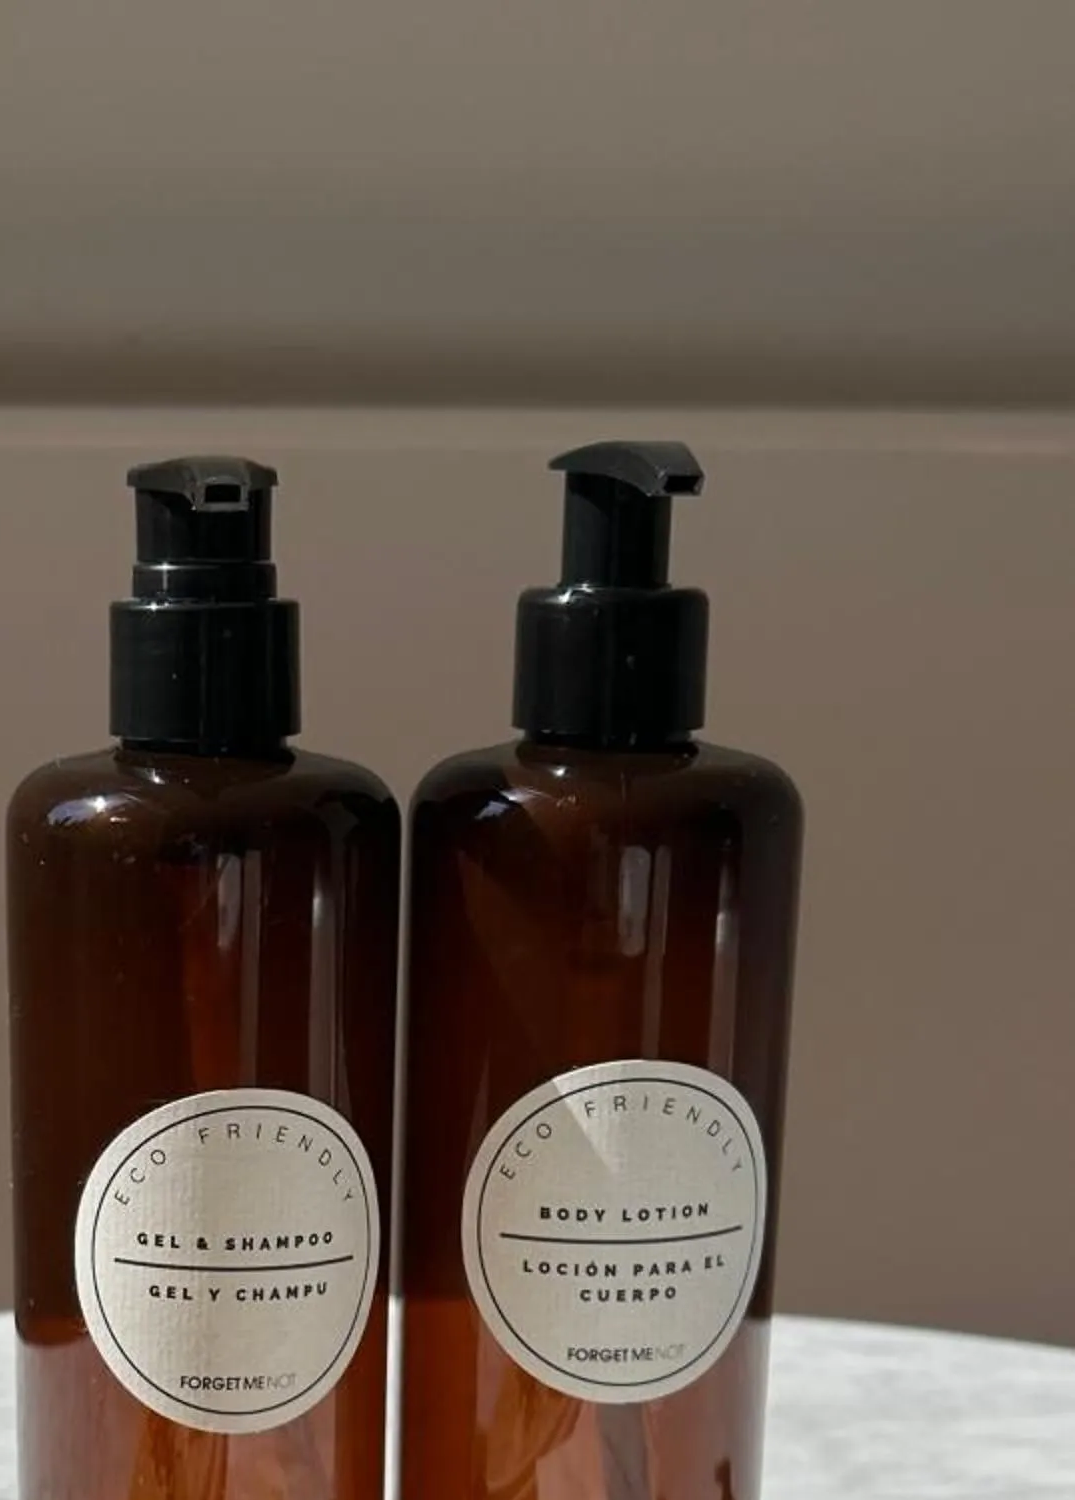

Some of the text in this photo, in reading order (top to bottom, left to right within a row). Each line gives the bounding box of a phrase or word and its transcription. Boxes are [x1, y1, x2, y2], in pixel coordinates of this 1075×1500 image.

[499, 1095, 743, 1180] ECO FRIENDLY
[114, 1123, 354, 1206] ECO FRIENDLY
[540, 1203, 710, 1223] BODY LOTION
[137, 1231, 334, 1251] GEL & SHAMPOO
[522, 1254, 726, 1278] LOCIÓN PARA EL
[148, 1282, 328, 1302] GEL Y CHAMPU
[580, 1287, 677, 1302] CUERPO
